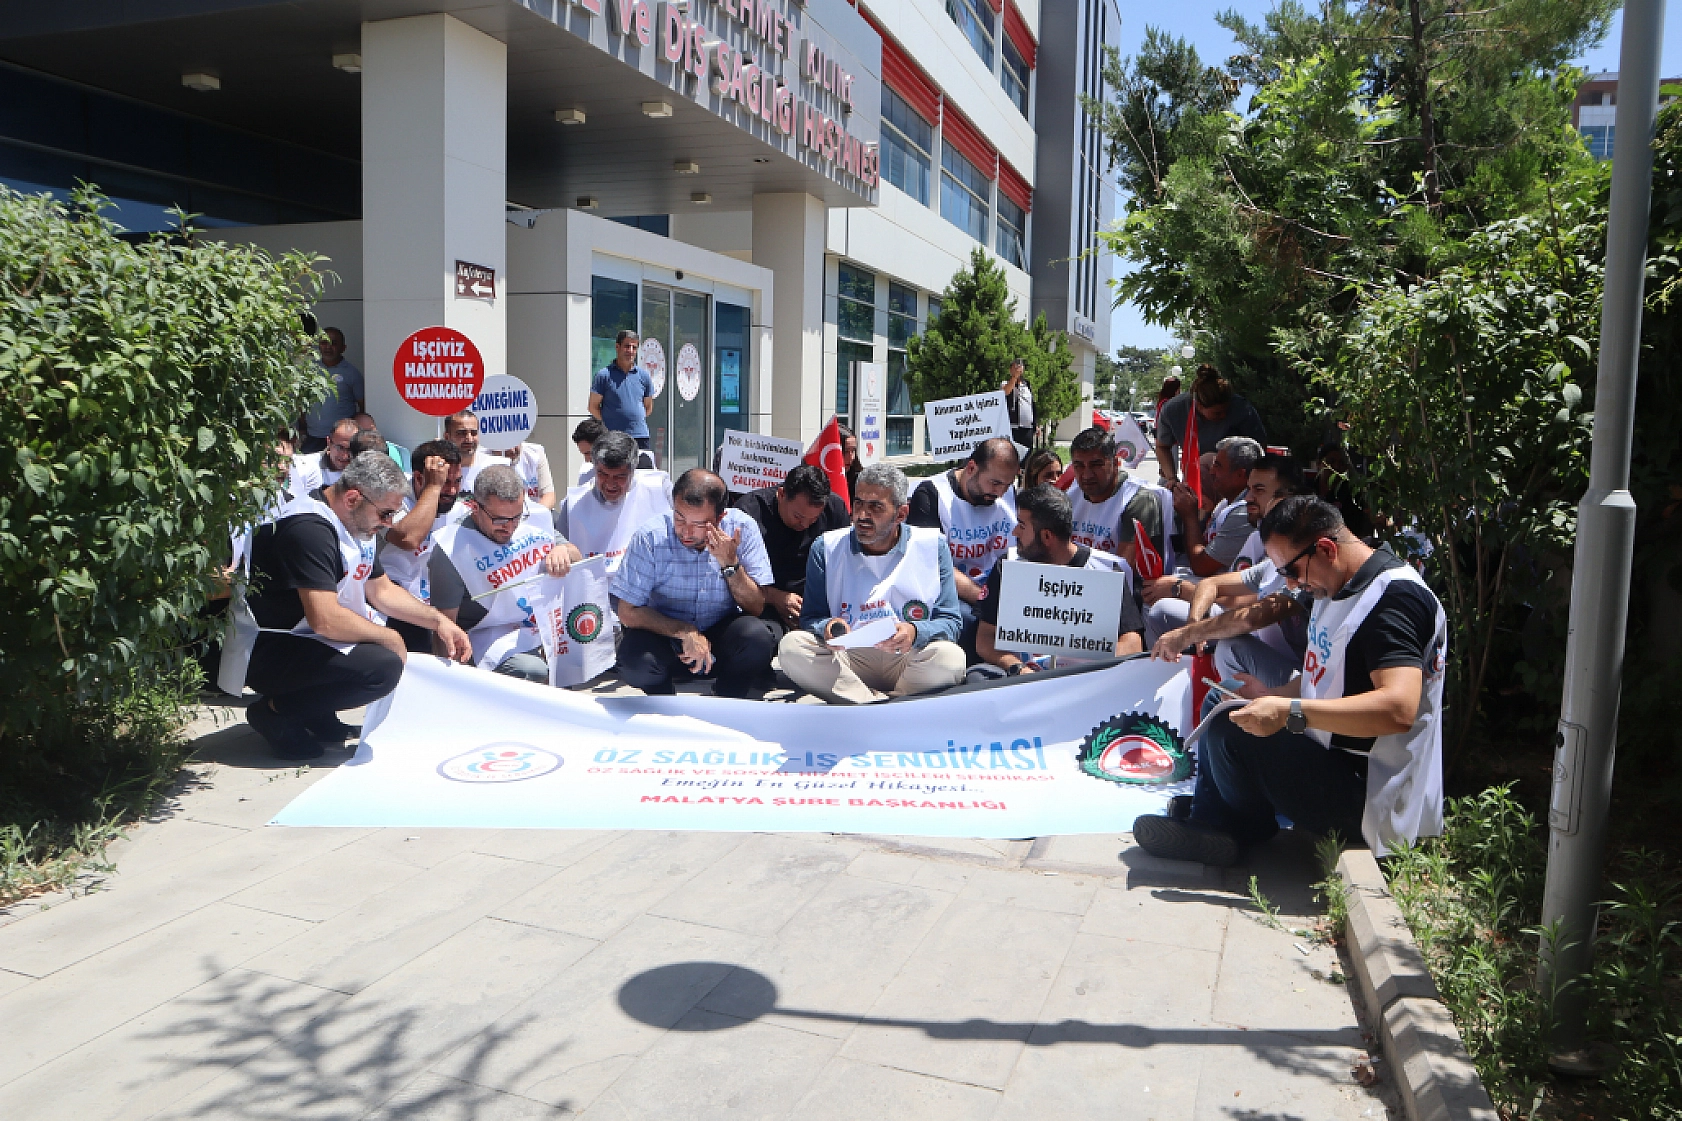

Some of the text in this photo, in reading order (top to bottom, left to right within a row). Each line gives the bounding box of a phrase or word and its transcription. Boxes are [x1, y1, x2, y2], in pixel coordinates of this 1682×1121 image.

[718, 0, 794, 60] HMET
[717, 42, 797, 137] SAĞLIĞI
[803, 102, 879, 189] HASTANESİ
[412, 336, 465, 361] İŞÇİYİZ
[404, 362, 474, 379] HAKLIYIZ
[404, 379, 474, 400] KAZANACAĞIZ
[479, 413, 530, 435] OKUNMA
[762, 467, 790, 480] SAĞLI
[1038, 574, 1084, 598] İşçiyiz
[1022, 605, 1095, 627] emekçiyiz
[998, 625, 1114, 653] hakkımızı isteriz
[592, 747, 643, 763] ÖZ
[851, 736, 1049, 770] SENDİKASI
[640, 795, 764, 805] MALATYA
